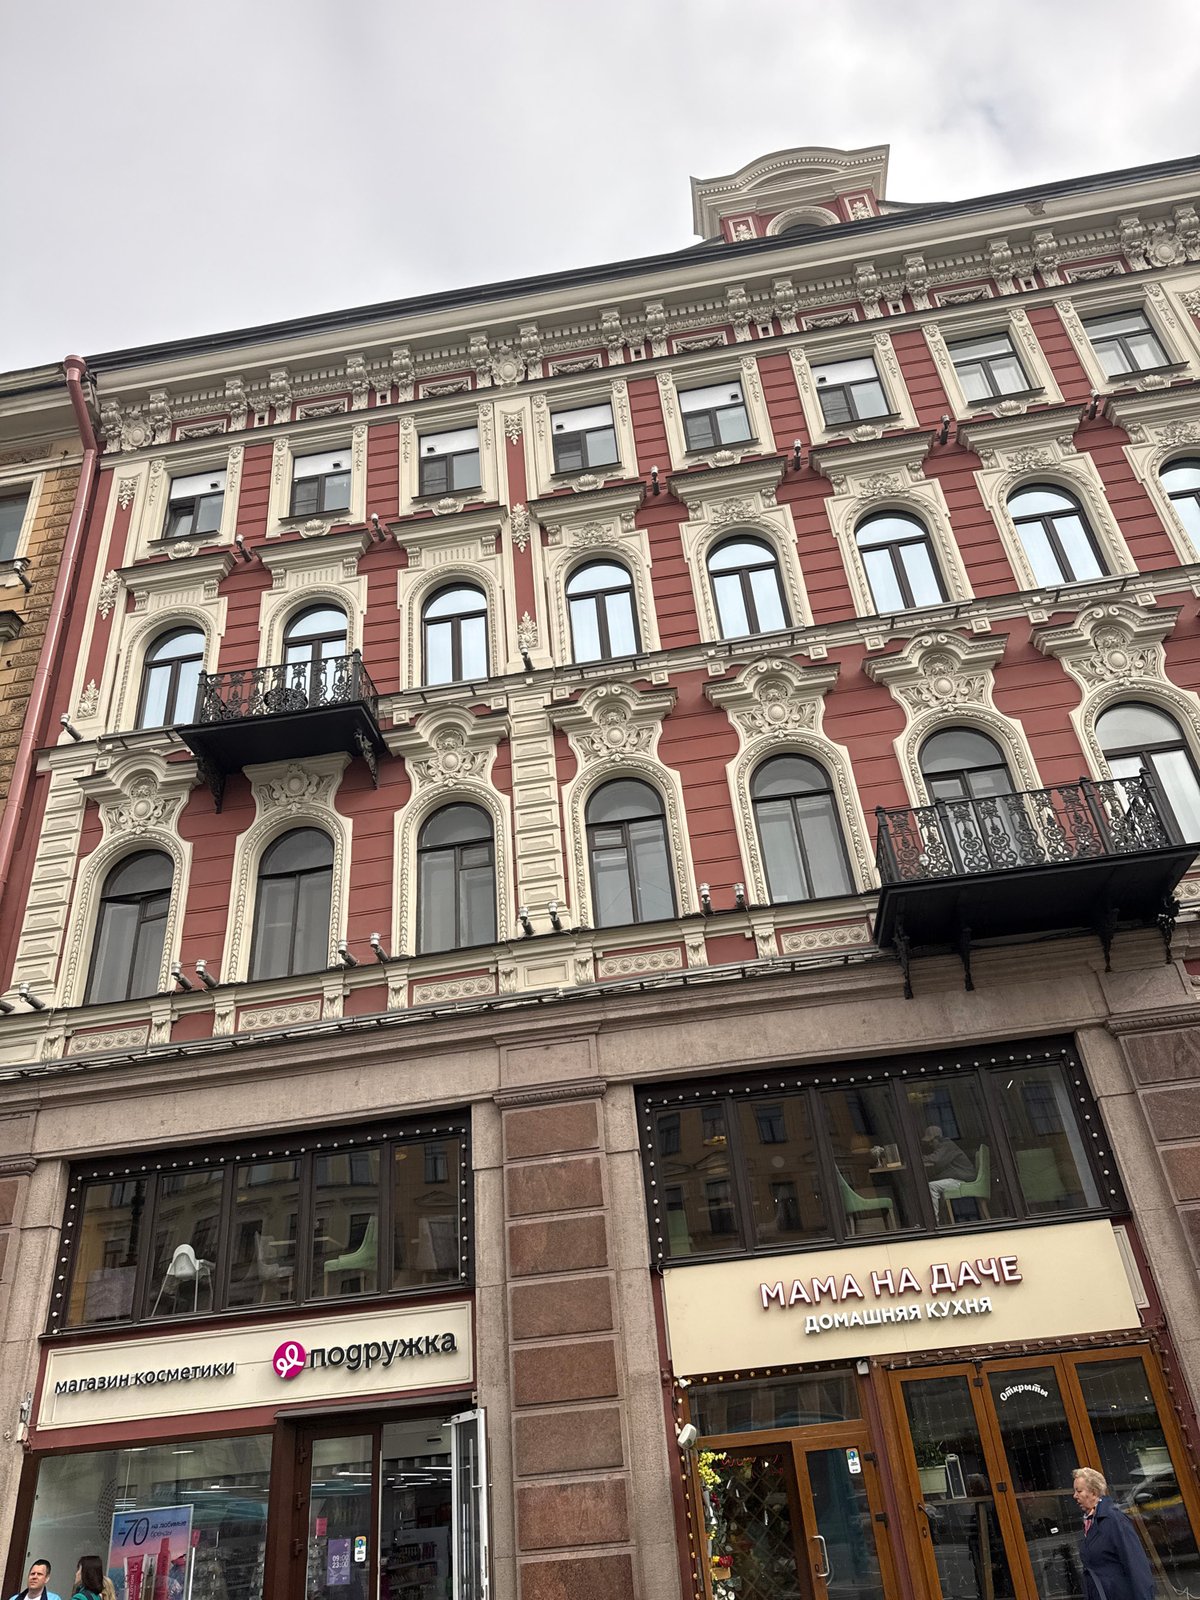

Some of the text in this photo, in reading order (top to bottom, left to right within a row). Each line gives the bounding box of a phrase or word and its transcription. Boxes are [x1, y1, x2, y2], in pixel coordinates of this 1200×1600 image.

[760, 1255, 1023, 1309] МАМА НА ДАЧЕ
[804, 1296, 993, 1334] ДОМАШНЯЯ КУХНЯ
[310, 1332, 458, 1370] подружка
[54, 1361, 236, 1395] магазин косметики
[1000, 1384, 1048, 1401] Открыты
